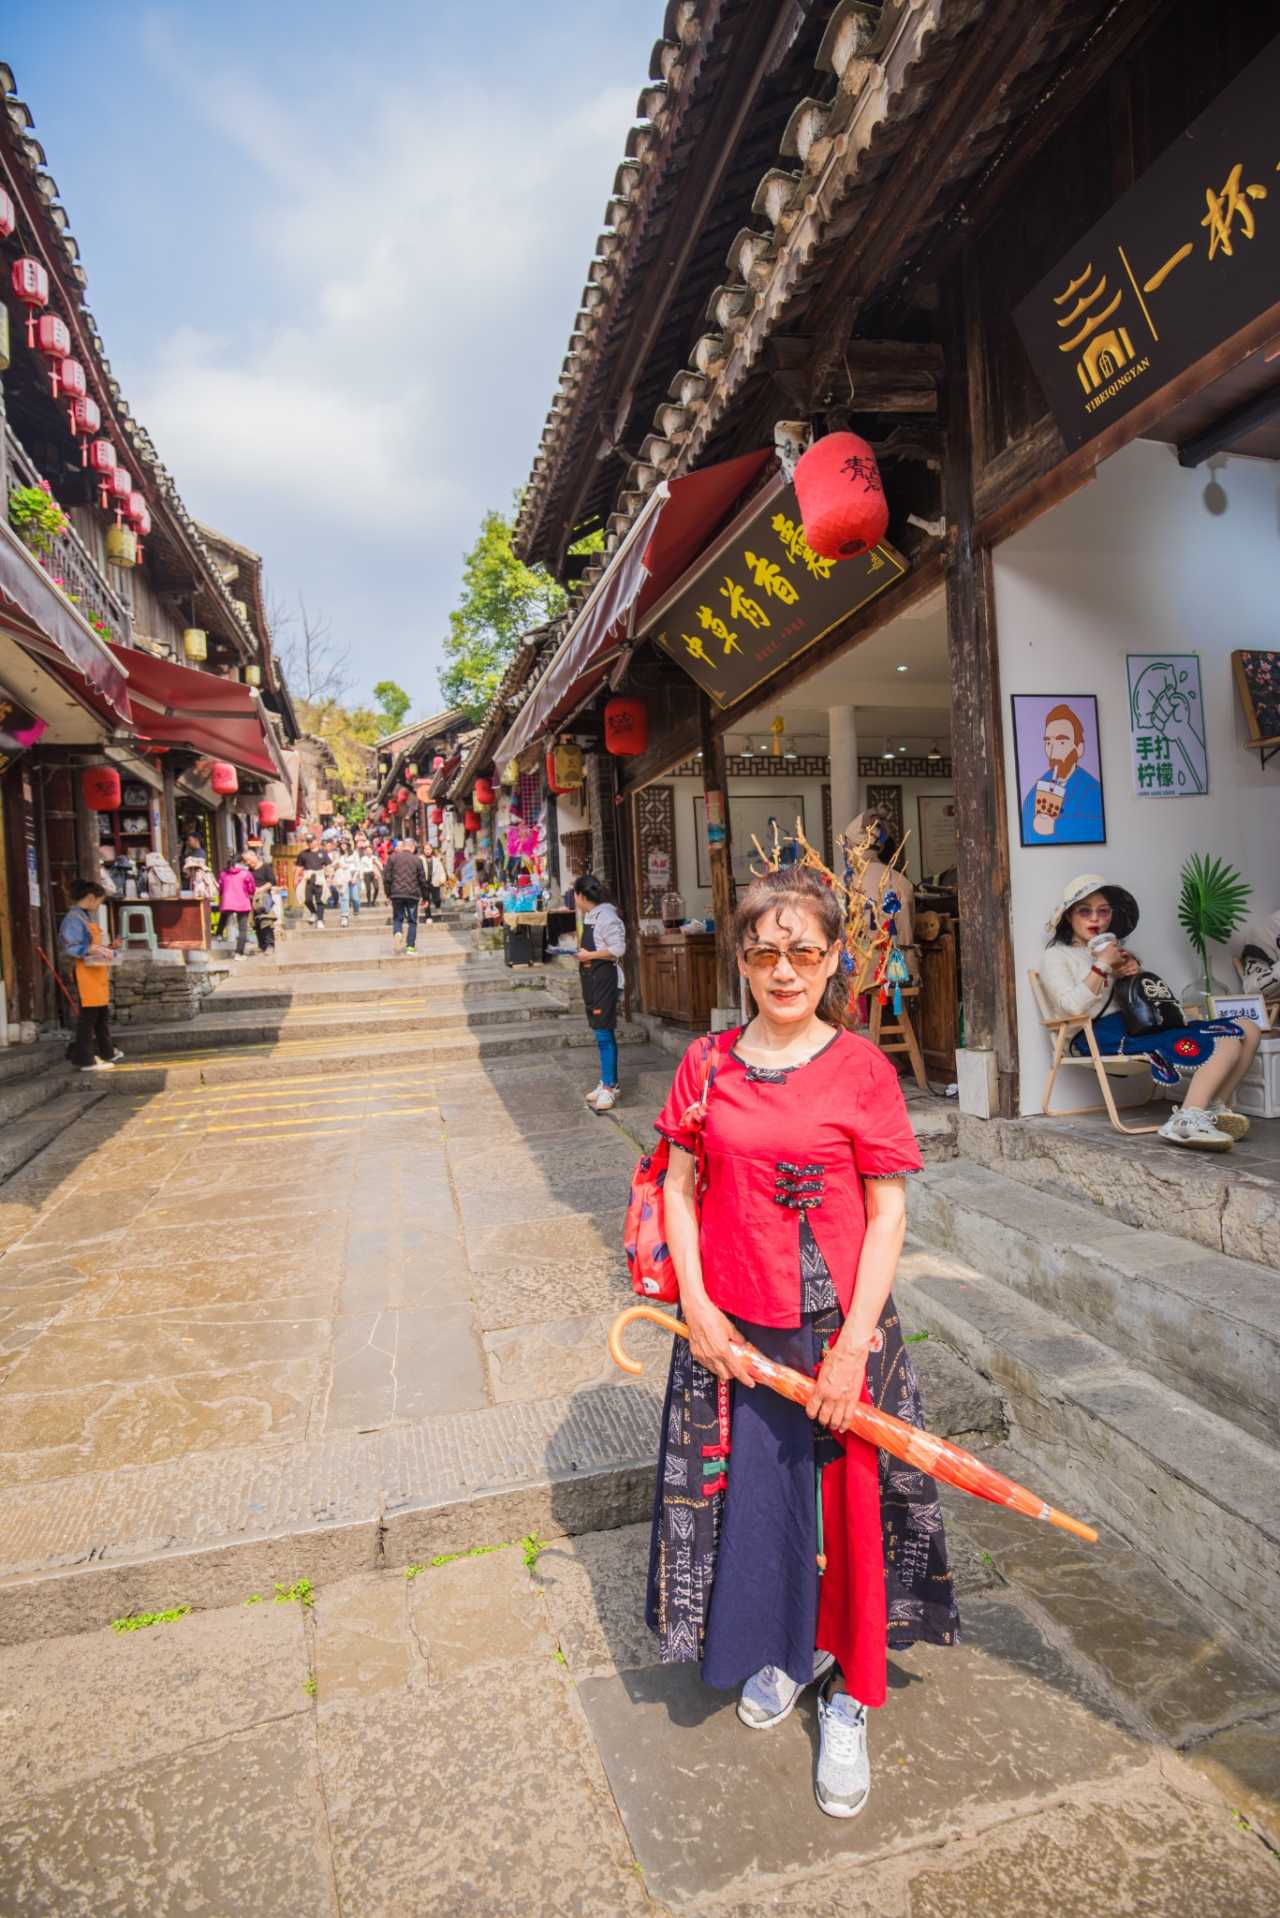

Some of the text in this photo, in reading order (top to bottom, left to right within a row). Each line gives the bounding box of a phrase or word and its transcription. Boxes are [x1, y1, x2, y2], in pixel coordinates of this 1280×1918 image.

[1144, 164, 1280, 292] 一杯
[1084, 356, 1151, 414] YIBEIQINGYAN
[1136, 735, 1170, 760] 手打
[1137, 762, 1174, 788] 柠檬
